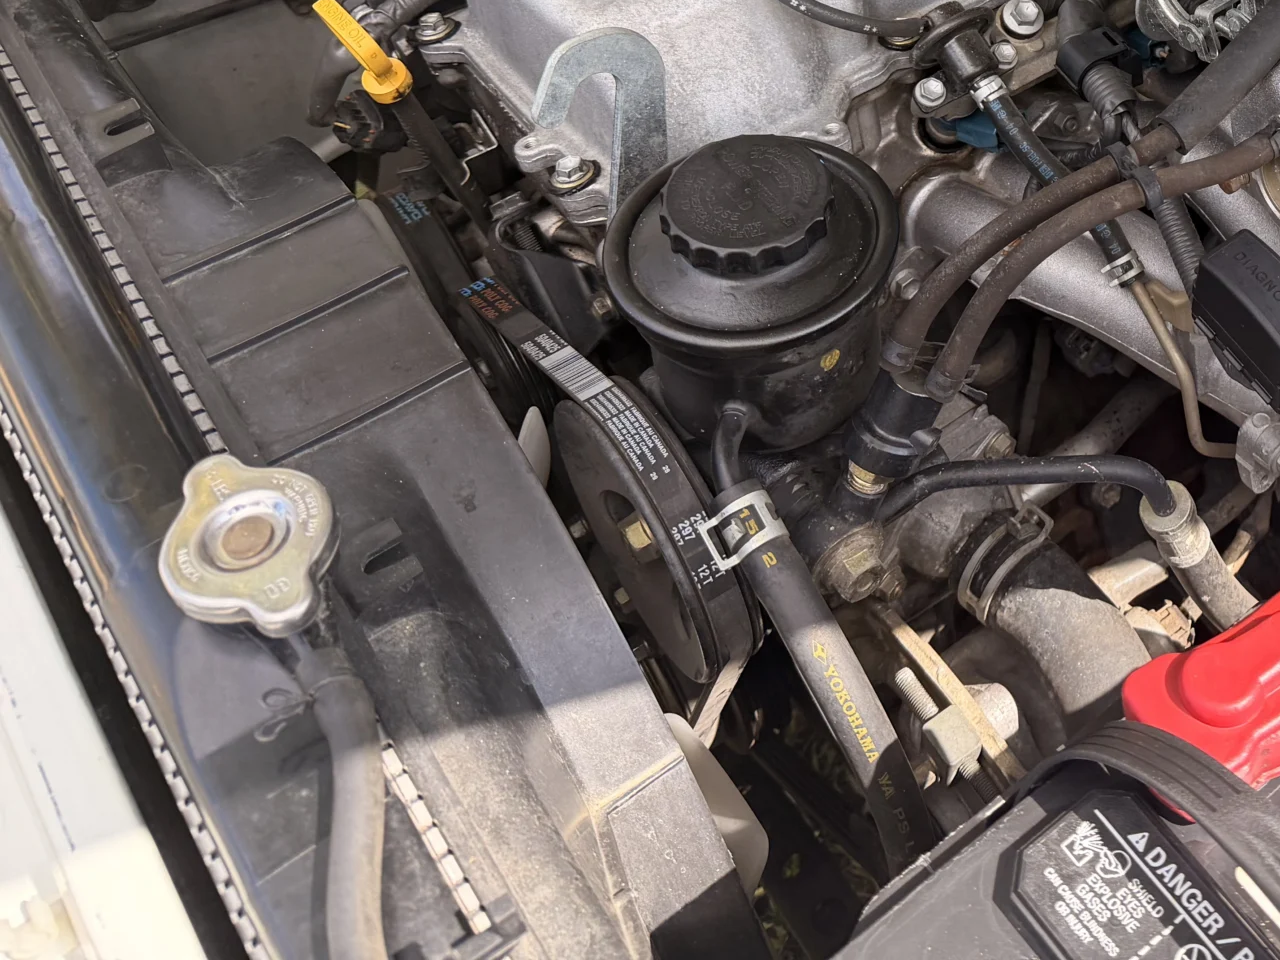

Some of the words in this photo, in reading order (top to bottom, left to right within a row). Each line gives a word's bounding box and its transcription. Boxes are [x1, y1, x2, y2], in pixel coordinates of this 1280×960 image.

[624, 432, 642, 455] CANADA
[636, 425, 655, 449] CANADA
[638, 440, 658, 465] CANADA
[650, 433, 670, 458] CANADA
[625, 446, 645, 472] CANADA
[678, 520, 696, 540] 297
[761, 551, 778, 568] 2
[823, 663, 881, 764] YOKOHAMA
[1076, 883, 1111, 922] GASES
[1086, 872, 1140, 933] EXPLOSIVE
[1116, 887, 1146, 919] EYES
[1128, 878, 1165, 918] SHIELD
[1144, 846, 1226, 936] DANGER
[1043, 867, 1062, 889] CAN
[1057, 881, 1085, 915] CAUSE
[1079, 907, 1120, 957] BLINDNESS
[1054, 901, 1069, 919] OR
[1066, 911, 1094, 945] INJURY
